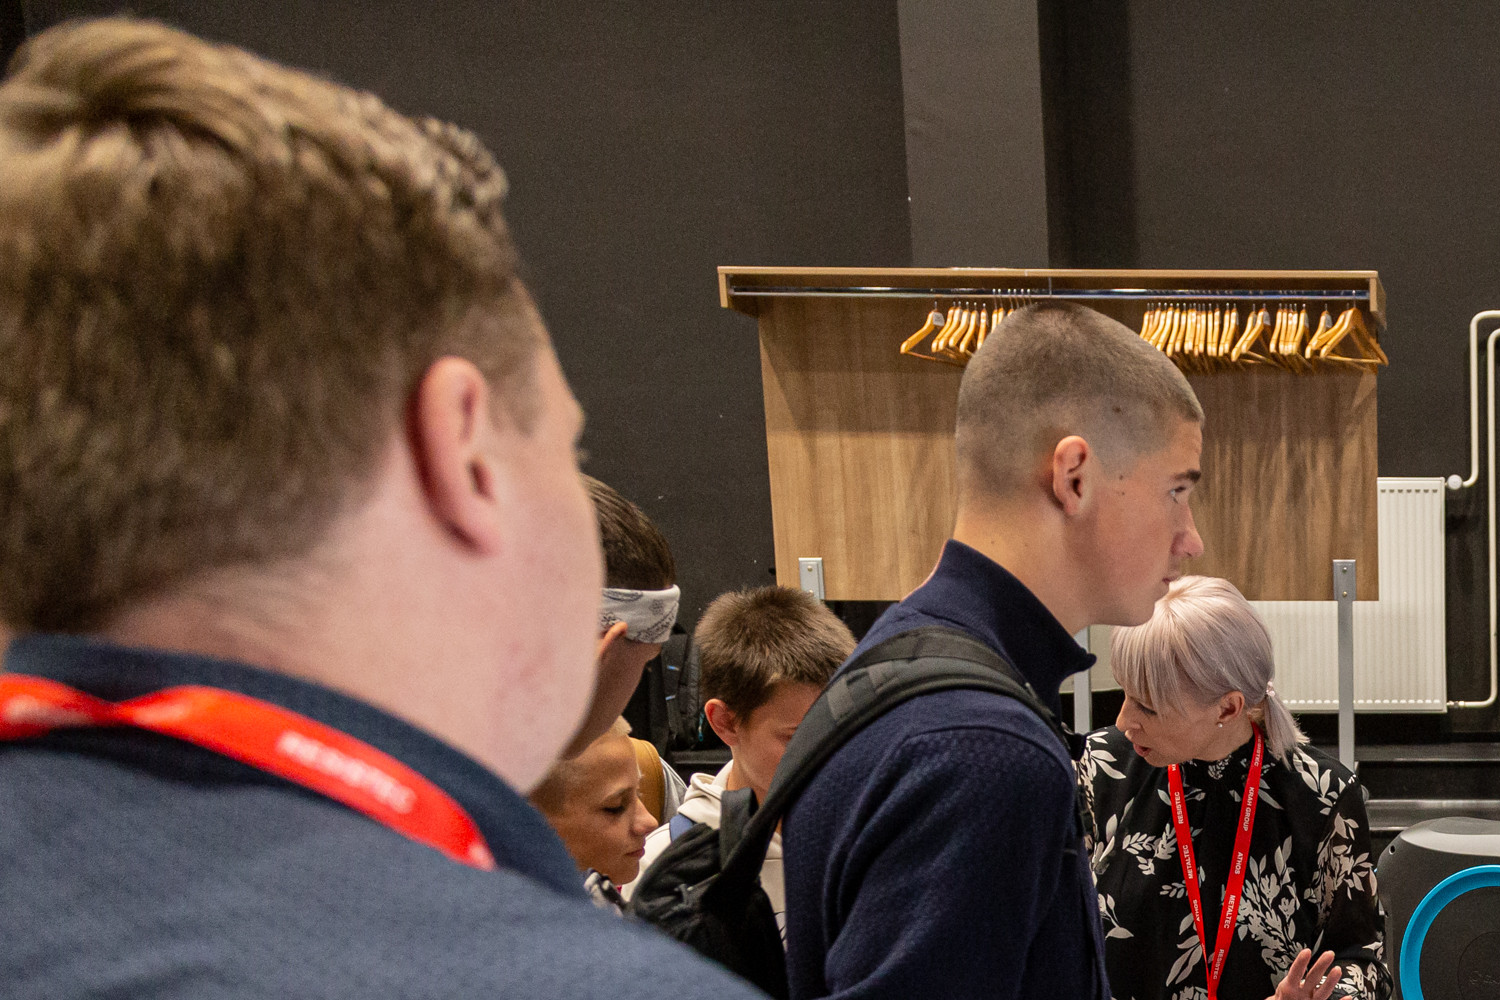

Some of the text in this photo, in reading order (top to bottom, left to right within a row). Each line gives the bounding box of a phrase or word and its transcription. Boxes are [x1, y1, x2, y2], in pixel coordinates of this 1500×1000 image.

[1174, 791, 1184, 824] RESISTEC
[1242, 786, 1255, 832] KRAH GROUP
[1182, 844, 1194, 880] METALTEC
[1234, 851, 1244, 875] ATHOS
[1193, 899, 1201, 922] ATHOS
[1223, 894, 1236, 929] METALTEC
[1212, 948, 1225, 980] RESISTEC
